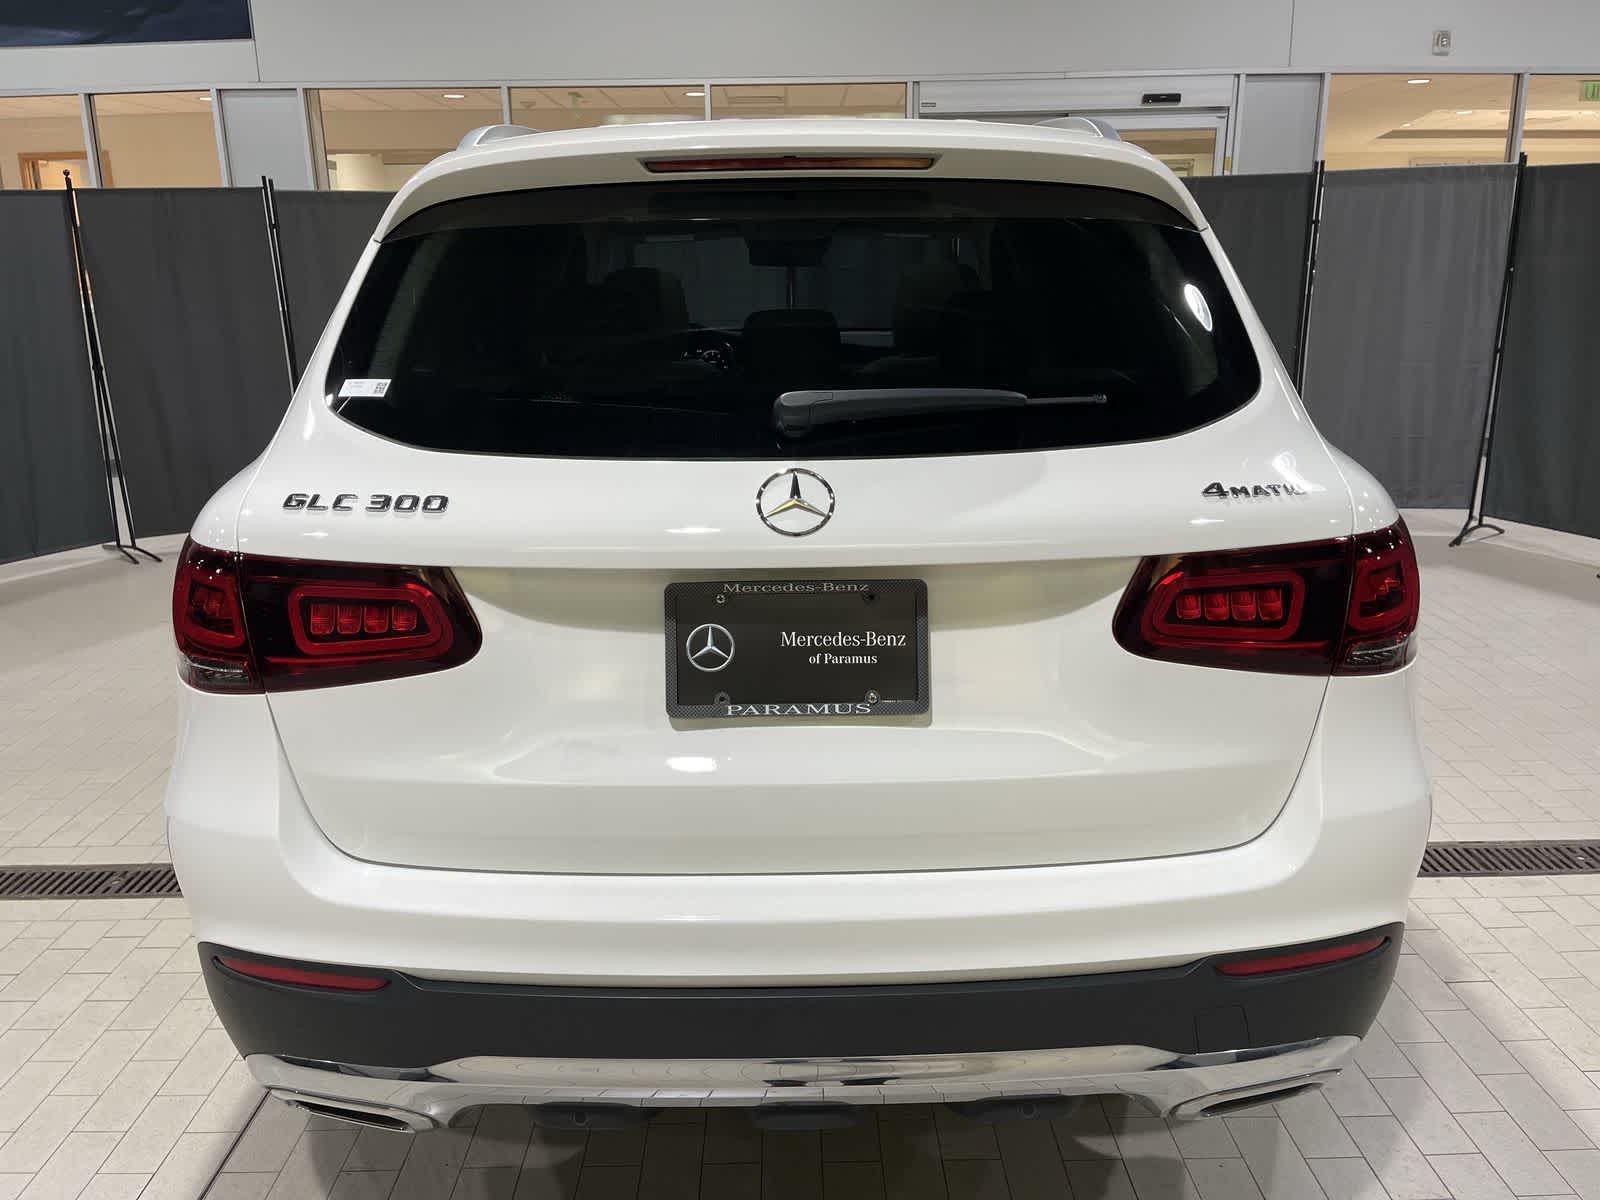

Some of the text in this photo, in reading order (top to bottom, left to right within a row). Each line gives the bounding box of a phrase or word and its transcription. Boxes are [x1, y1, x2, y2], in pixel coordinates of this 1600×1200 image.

[282, 493, 449, 513] GLC 300
[723, 582, 870, 593] Mercedes-Benz
[780, 631, 907, 647] Mercedes-Benz
[808, 653, 878, 664] of Paramus
[727, 703, 871, 716] PARAMUS
